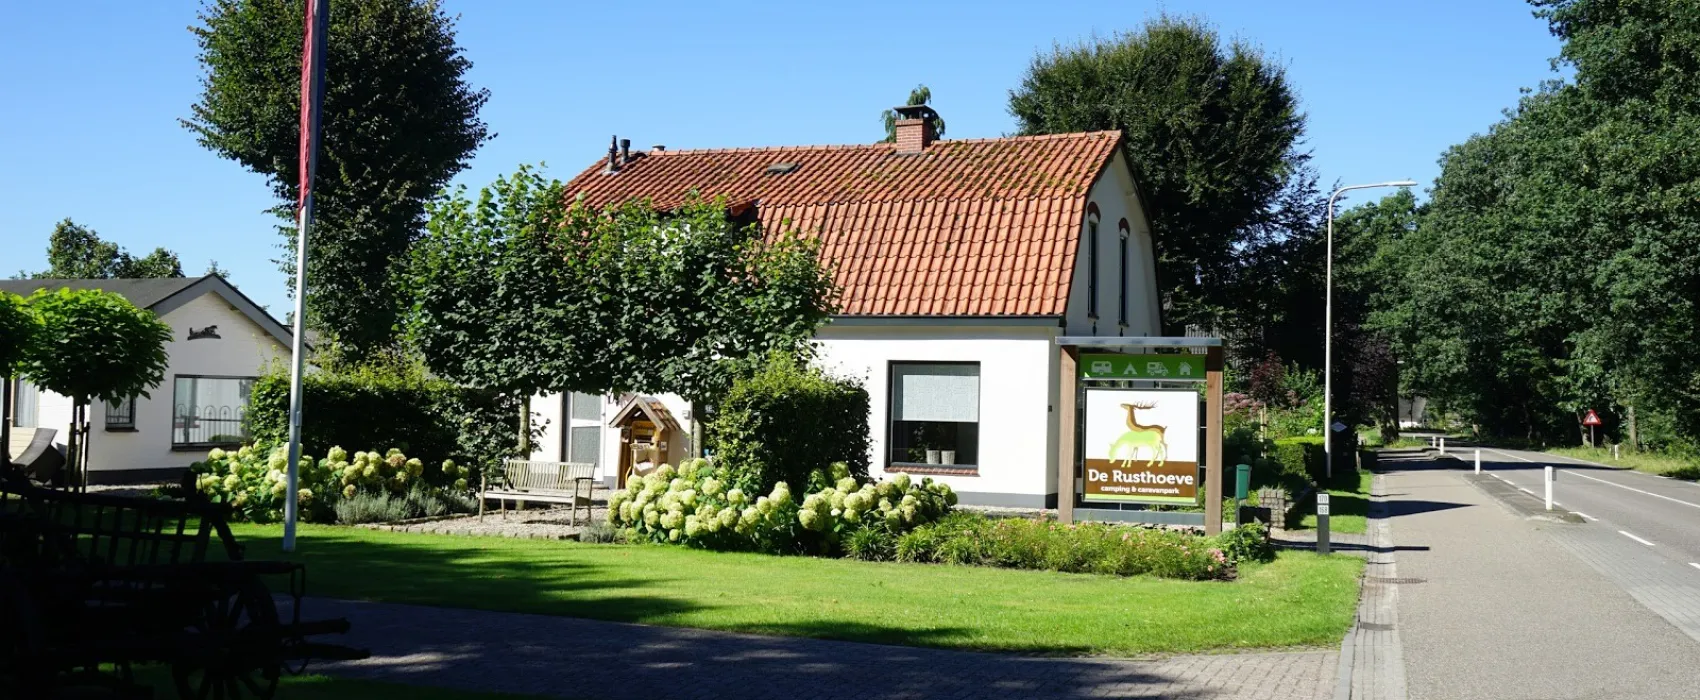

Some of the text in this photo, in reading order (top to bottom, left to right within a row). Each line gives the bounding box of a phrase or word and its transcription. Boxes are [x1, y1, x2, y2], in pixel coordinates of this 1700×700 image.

[1088, 469, 1193, 485] De Rusthoeve
[1101, 485, 1130, 494] camping
[1138, 487, 1180, 495] caravanpark
